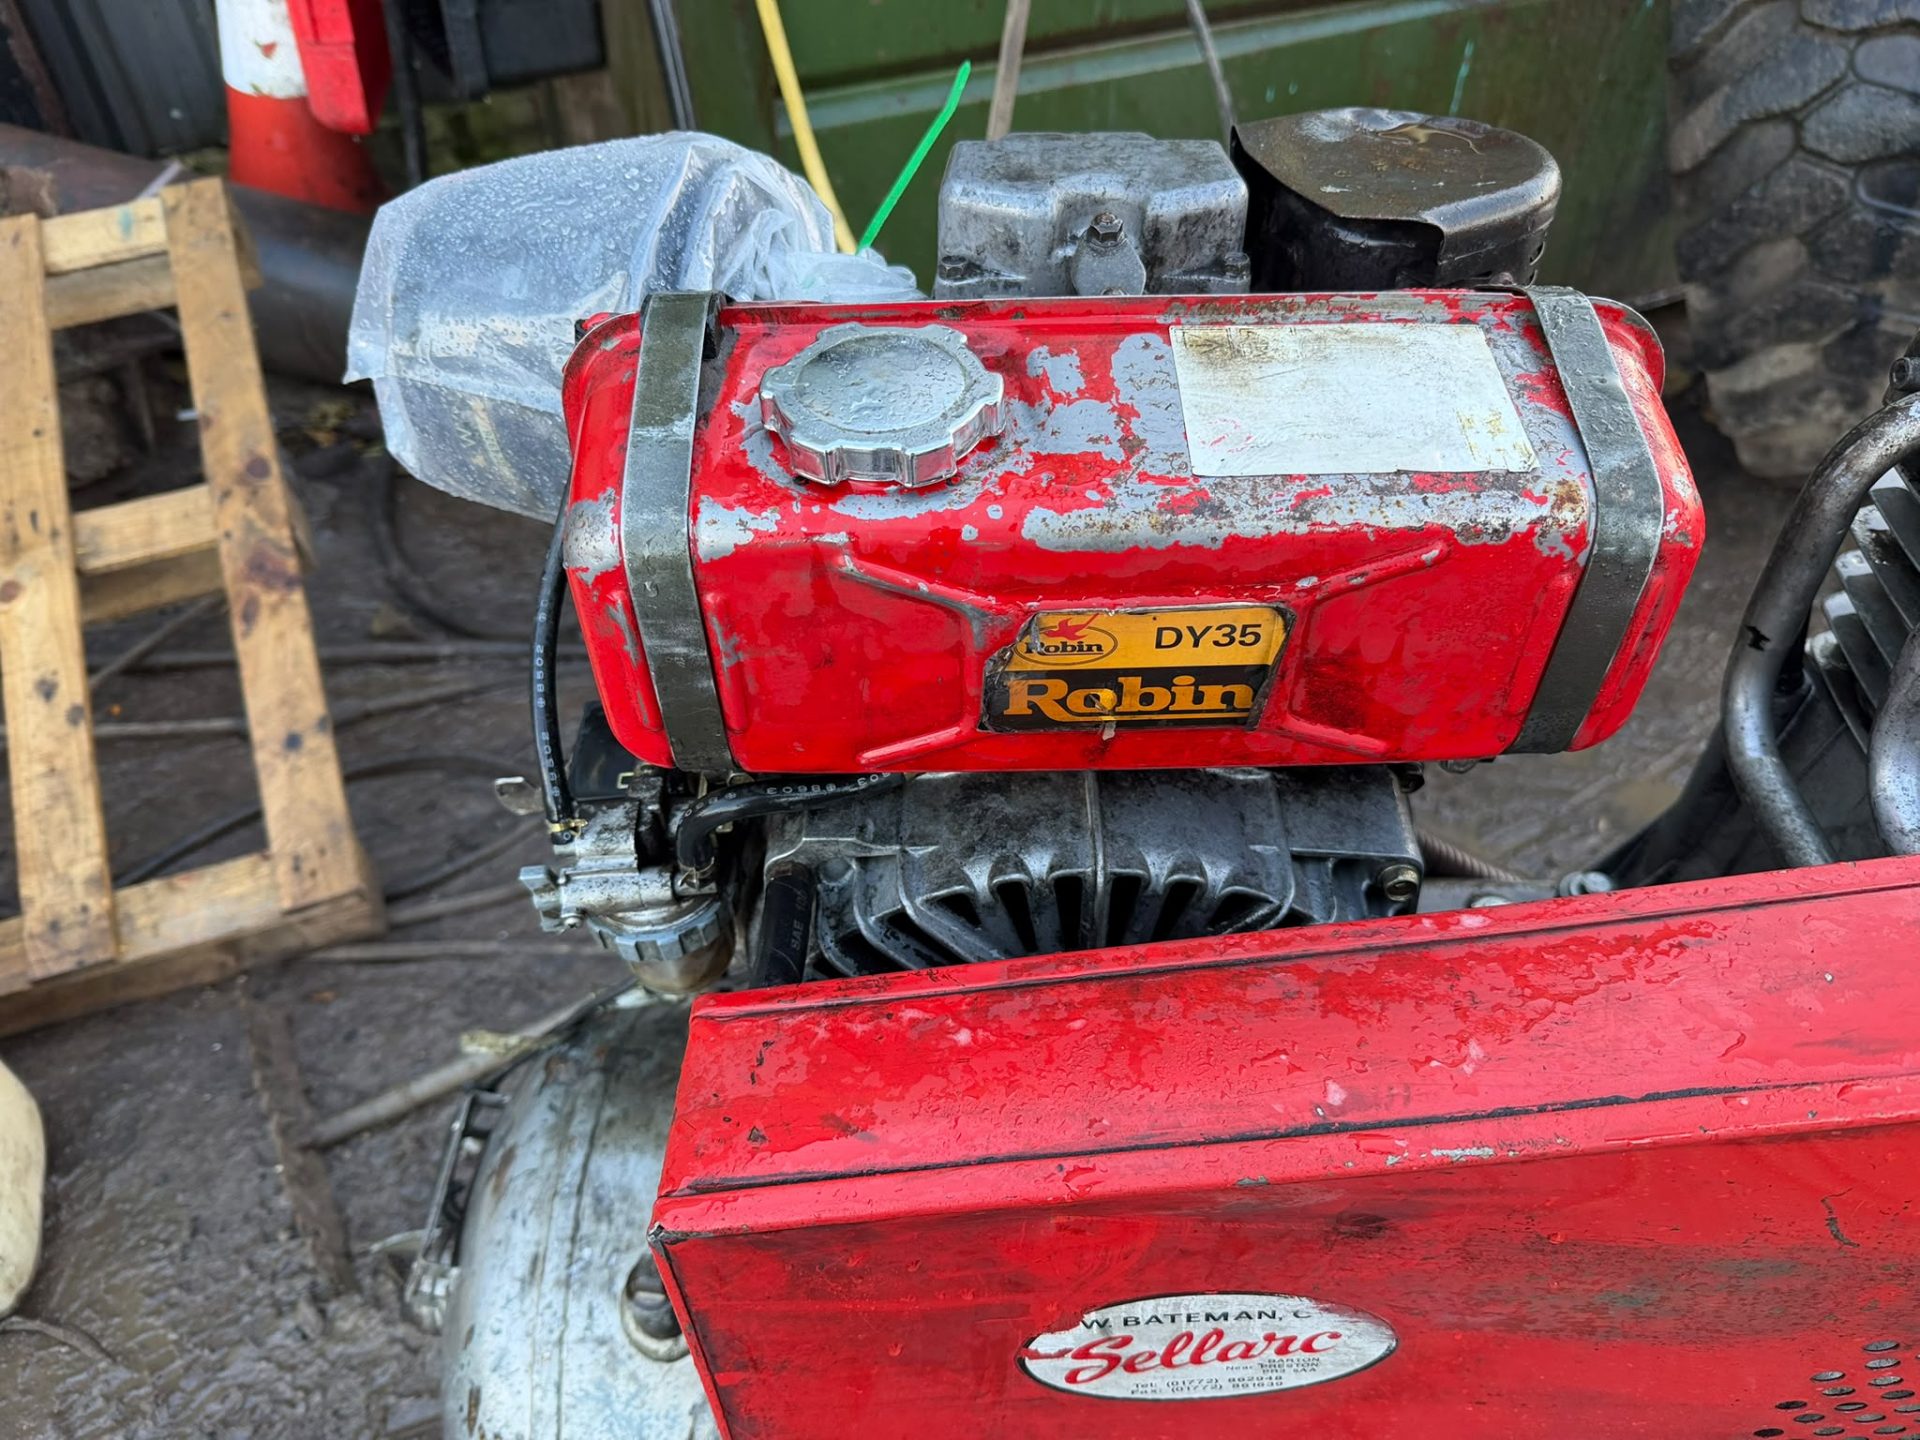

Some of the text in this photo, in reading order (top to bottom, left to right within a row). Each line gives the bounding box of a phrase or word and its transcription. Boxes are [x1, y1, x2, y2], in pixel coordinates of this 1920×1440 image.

[1025, 641, 1104, 656] Robin
[1154, 623, 1263, 650] DY35
[1004, 675, 1254, 723] Robin
[1081, 1317, 1112, 1329] W.
[1123, 1310, 1283, 1327] BATEMAN,
[1062, 1327, 1343, 1385] Sellarc
